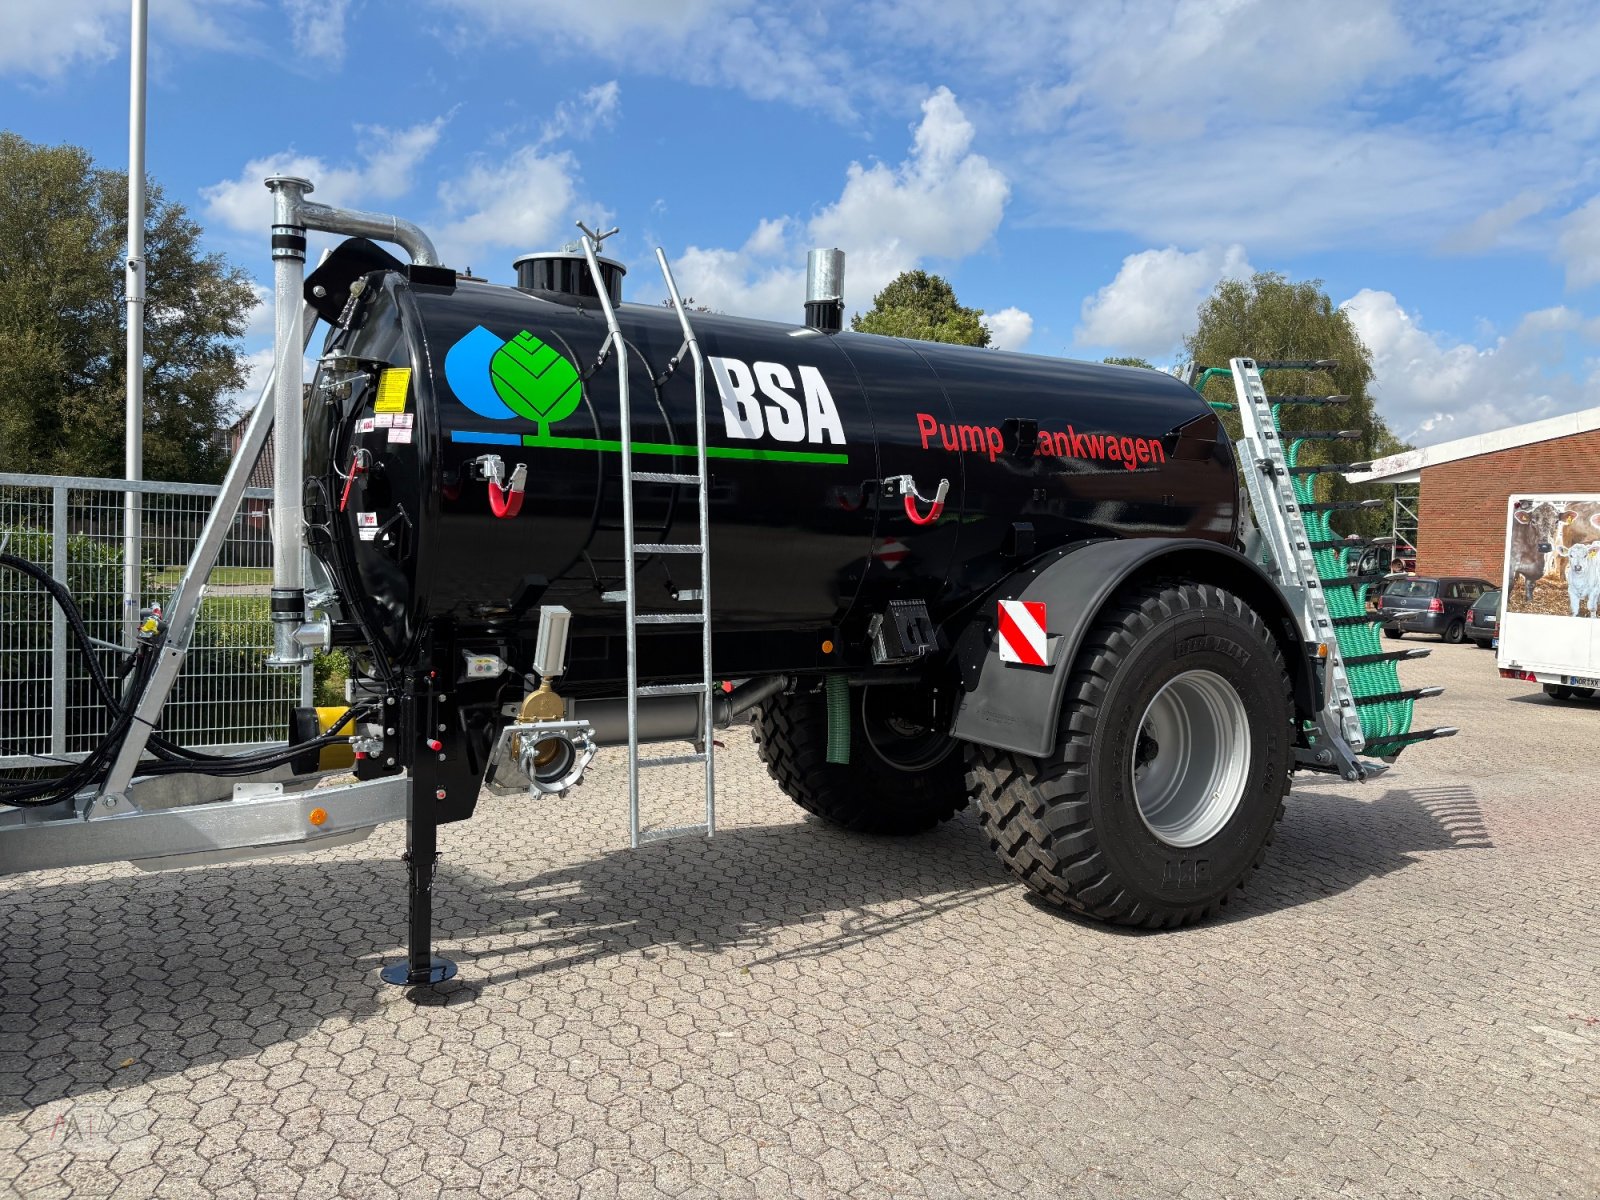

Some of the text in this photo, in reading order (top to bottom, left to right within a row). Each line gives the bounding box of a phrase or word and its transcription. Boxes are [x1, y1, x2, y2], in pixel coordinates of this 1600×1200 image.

[708, 356, 847, 445] BSA
[916, 413, 1166, 471] Pump ankwagen
